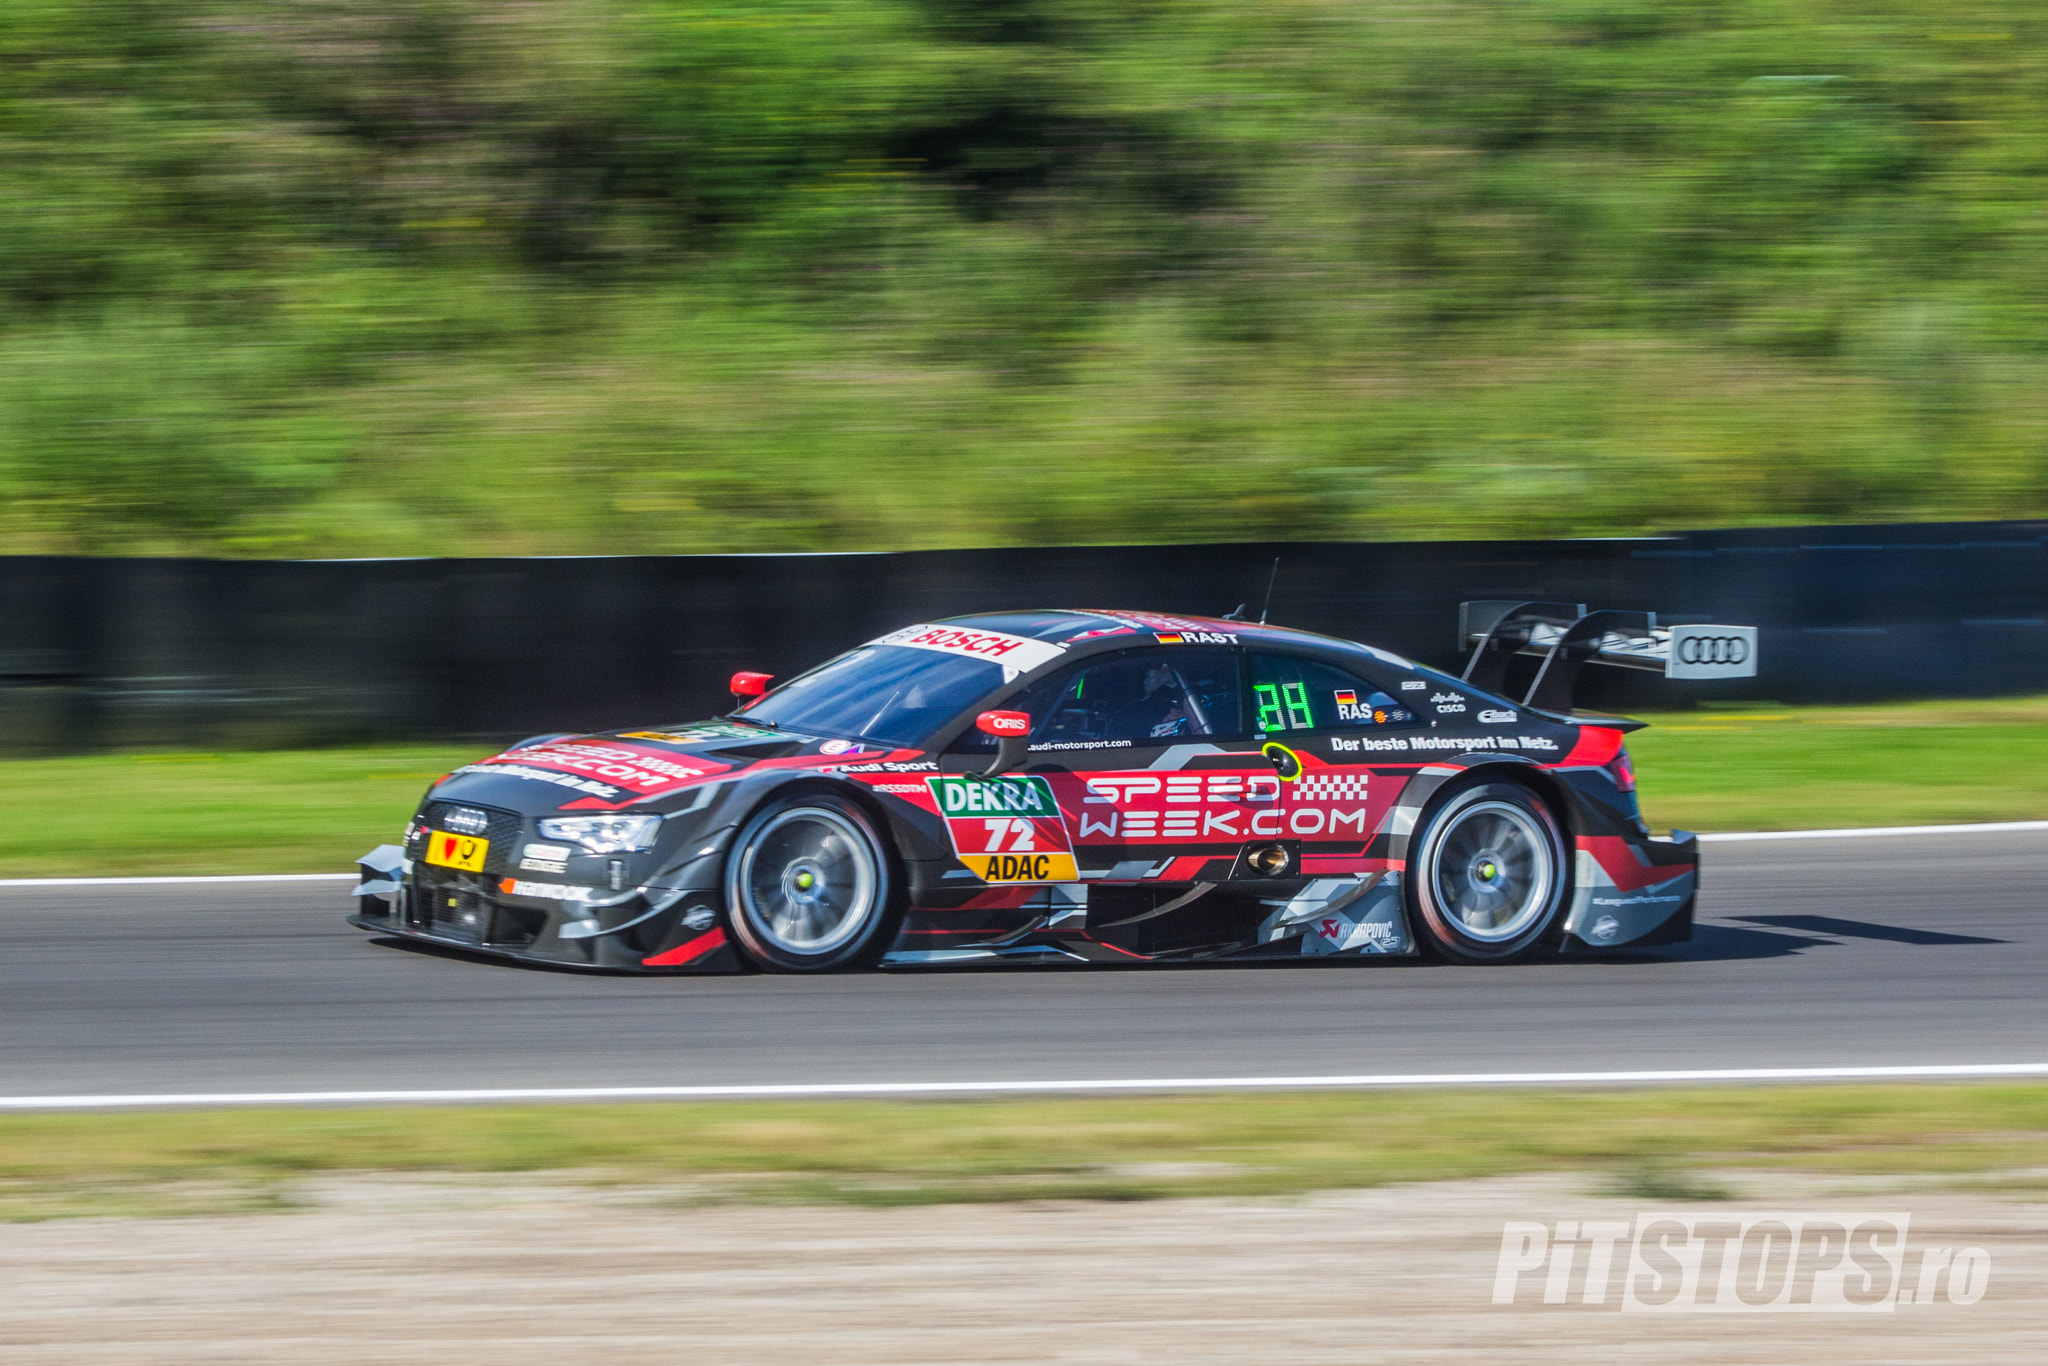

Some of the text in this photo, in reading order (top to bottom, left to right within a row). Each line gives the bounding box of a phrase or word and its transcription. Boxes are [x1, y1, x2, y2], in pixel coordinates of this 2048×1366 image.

[908, 629, 1024, 656] BOSCH
[1179, 631, 1239, 645] RAST
[1337, 702, 1373, 720] RAS
[993, 718, 1025, 730] ORIS
[1330, 737, 1360, 751] Der
[1362, 737, 1408, 750] beste
[1409, 736, 1497, 752] Motorsport
[1496, 736, 1520, 749] im
[840, 761, 939, 773] Audi Sport
[944, 782, 1043, 811] DEKRA
[1082, 775, 1280, 804] SPEED
[984, 818, 1035, 851] 72
[1079, 808, 1366, 838] WEEK.COM
[985, 855, 1049, 880] ADAC
